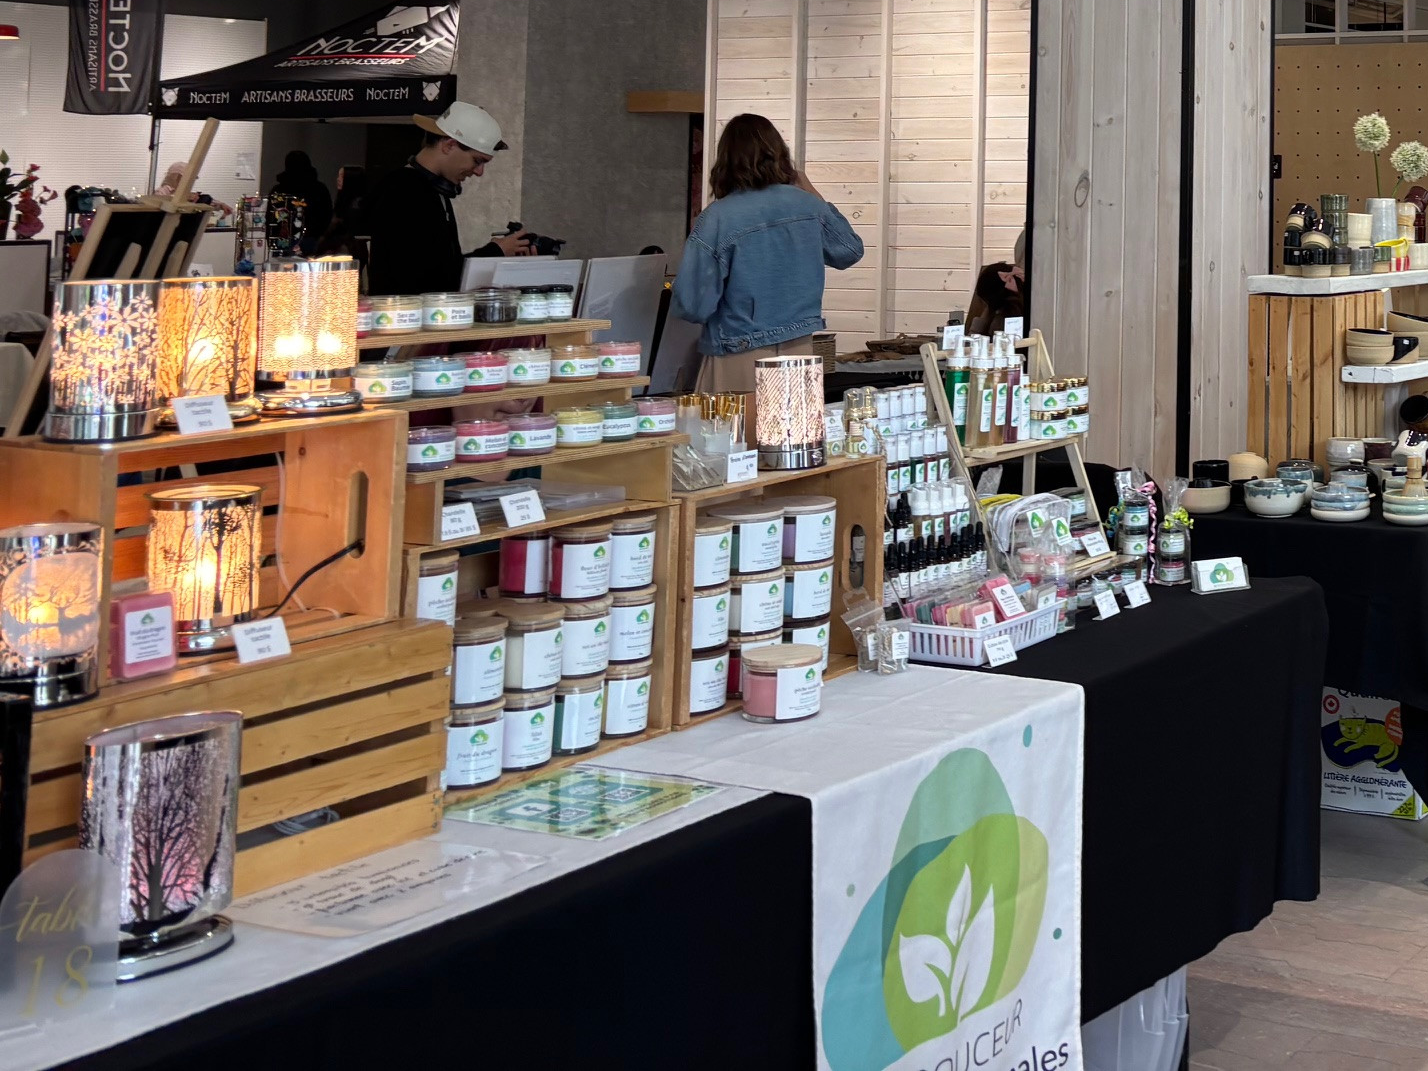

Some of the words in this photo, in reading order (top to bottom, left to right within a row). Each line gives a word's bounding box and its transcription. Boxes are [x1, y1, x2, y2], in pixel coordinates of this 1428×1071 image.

[241, 90, 293, 103] ARTISANS
[294, 89, 354, 102] BRASSEURS
[919, 998, 1023, 1071] OUCEUR
[1009, 1042, 1069, 1071] ales
